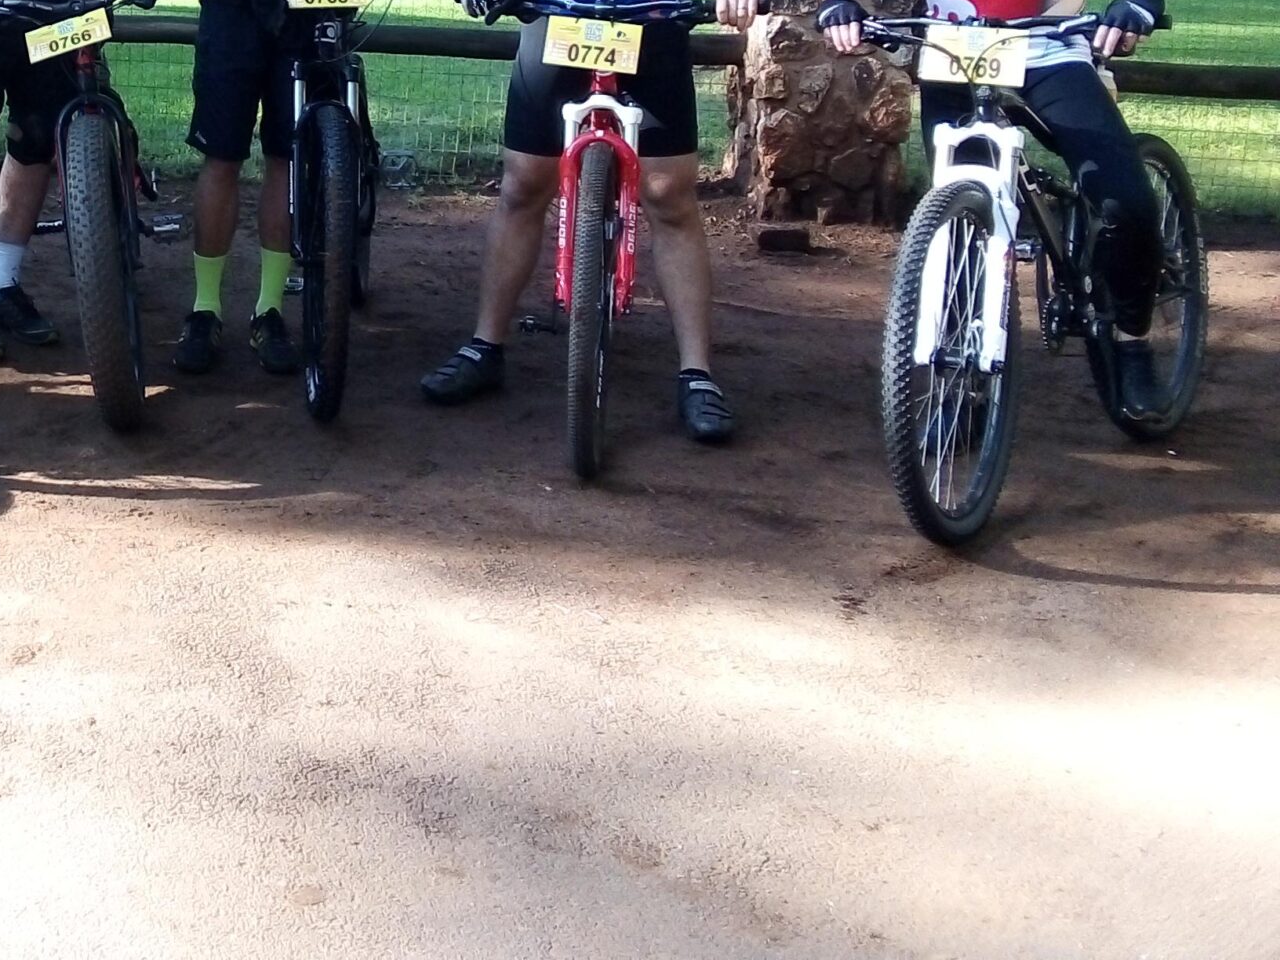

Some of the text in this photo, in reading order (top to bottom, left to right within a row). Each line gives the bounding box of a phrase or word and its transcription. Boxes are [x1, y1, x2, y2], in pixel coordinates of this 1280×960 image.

[49, 29, 92, 52] 0766
[567, 43, 616, 67] 0774
[949, 56, 1001, 79] 0769
